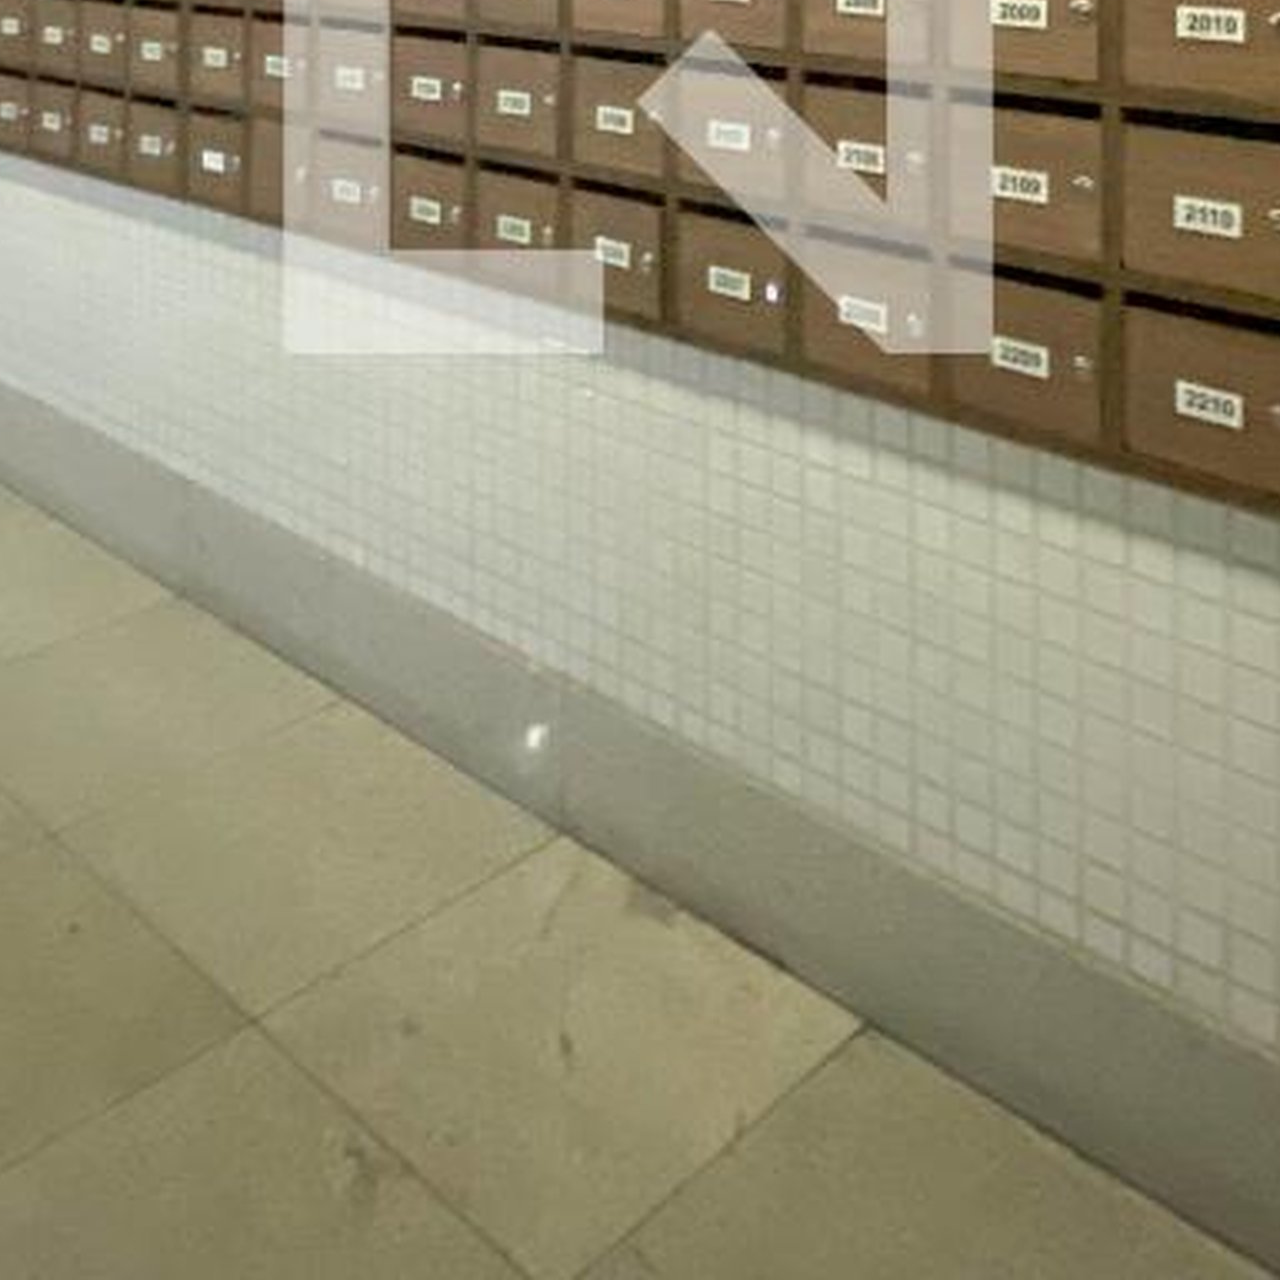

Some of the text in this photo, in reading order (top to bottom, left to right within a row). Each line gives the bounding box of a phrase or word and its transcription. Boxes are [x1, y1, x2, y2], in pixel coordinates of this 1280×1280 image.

[998, 2, 1041, 22] 2009
[1185, 12, 1237, 35] 2010
[998, 172, 1041, 195] 2109
[1184, 205, 1235, 231] 2110
[1183, 388, 1235, 417] 2210
